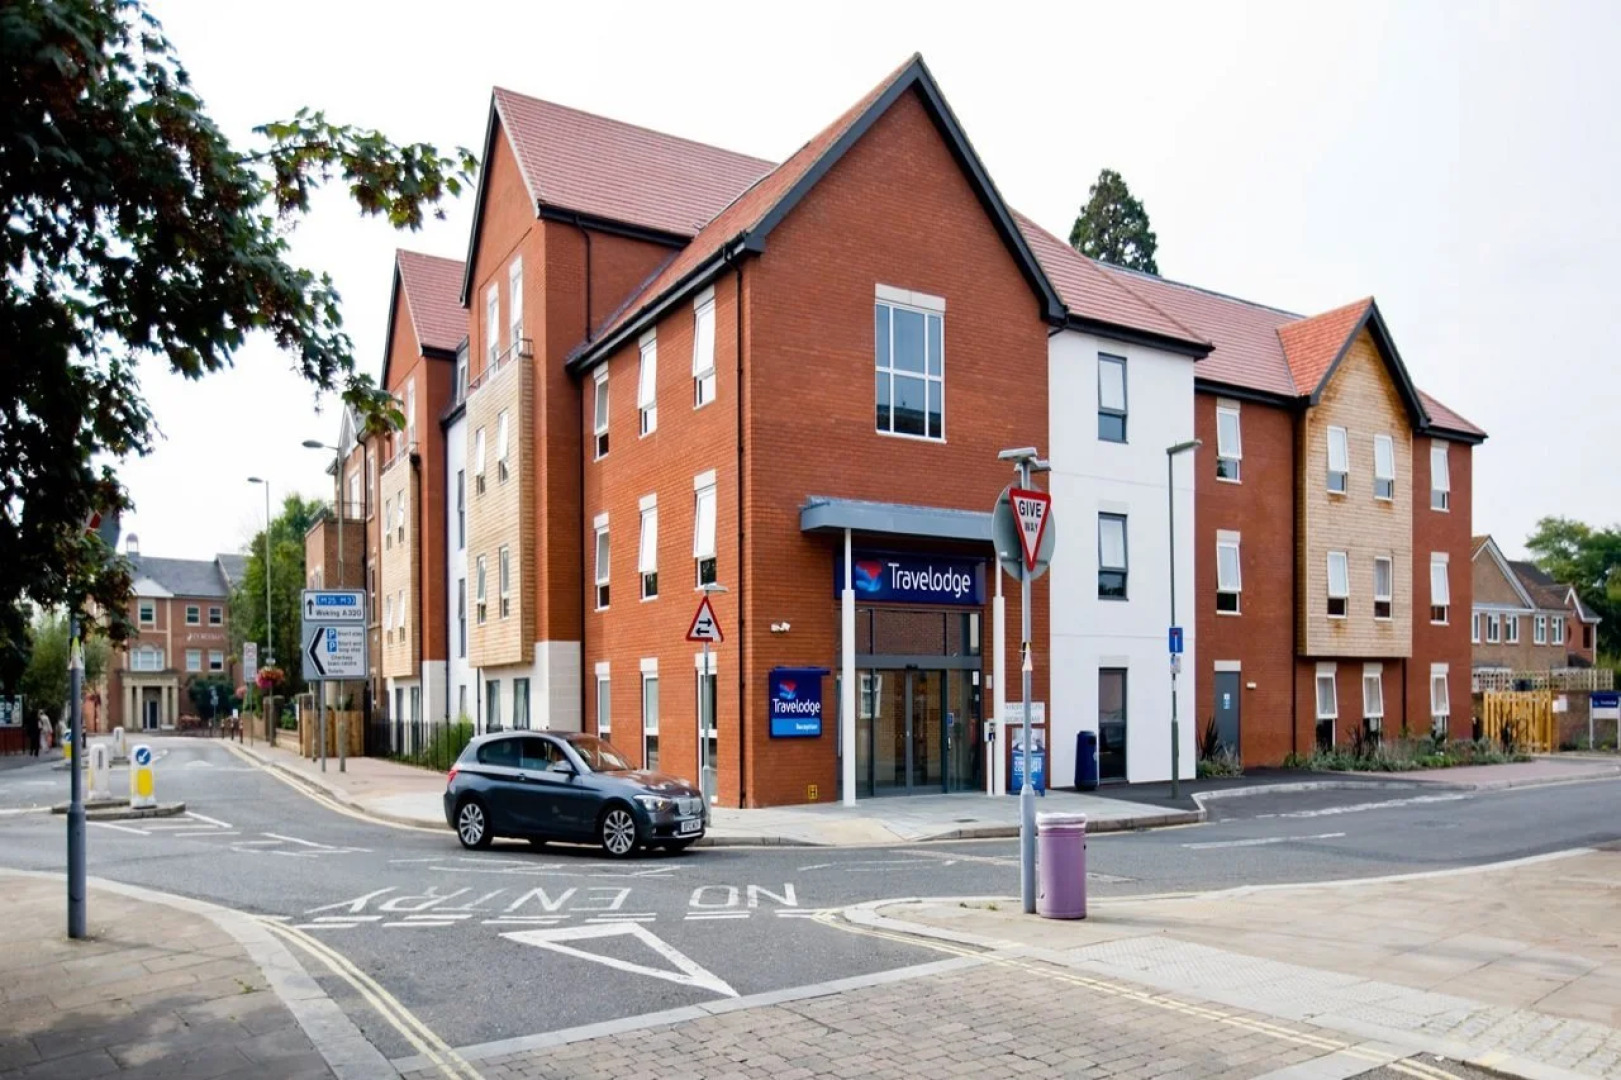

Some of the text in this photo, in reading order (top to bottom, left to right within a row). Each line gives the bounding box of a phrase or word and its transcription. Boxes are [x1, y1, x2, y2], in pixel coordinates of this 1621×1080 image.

[1018, 499, 1042, 518] GIVE
[1024, 521, 1039, 533] WAY
[887, 562, 971, 599] Travelodge
[316, 609, 340, 617] Woking
[772, 698, 821, 716] Travelodge
[304, 883, 799, 914] NO ENTRY
